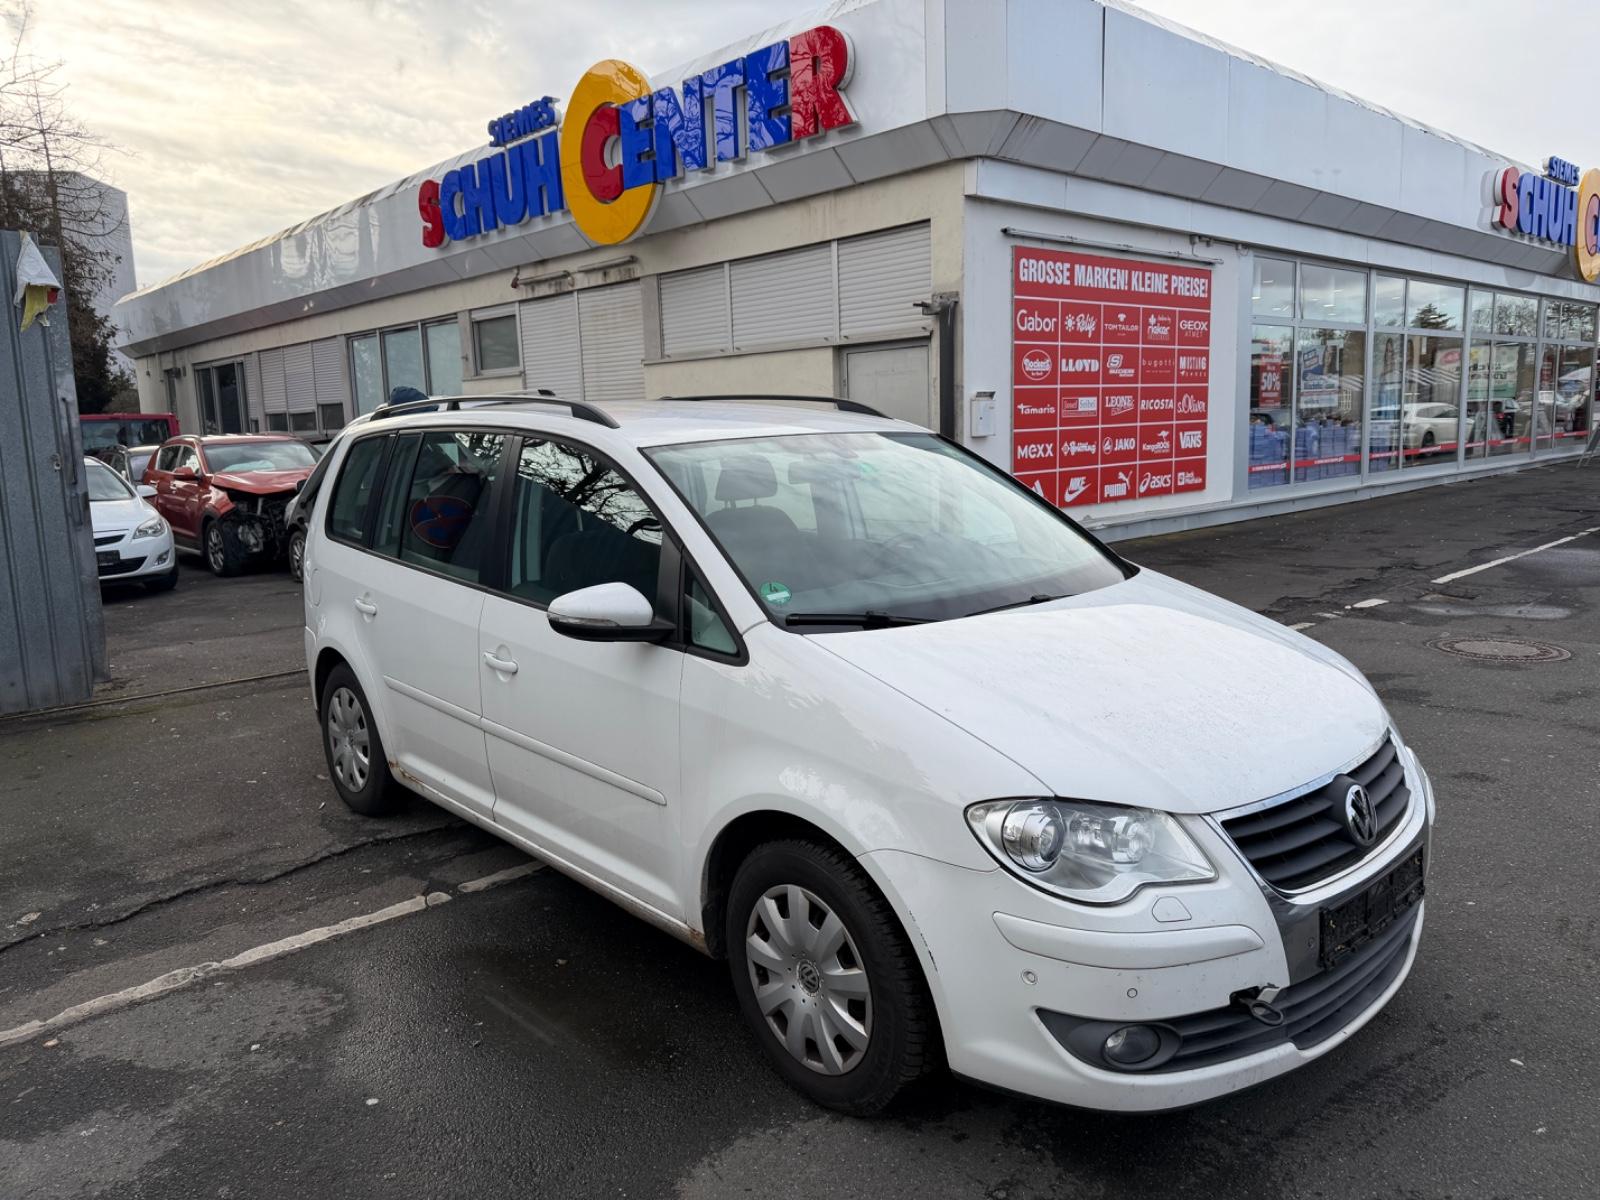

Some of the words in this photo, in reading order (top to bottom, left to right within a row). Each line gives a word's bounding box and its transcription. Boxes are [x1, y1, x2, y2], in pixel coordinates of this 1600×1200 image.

[488, 96, 557, 147] SIEMES
[418, 131, 565, 248] SCHUH
[581, 25, 857, 203] CENTER
[1500, 167, 1578, 246] SCHUH
[1019, 258, 1071, 285] GROSSE
[1074, 264, 1128, 290] MARKEN!
[1131, 271, 1168, 294] KLEINE
[1171, 275, 1208, 298] PREISE!
[1017, 309, 1057, 332] Gabor
[1180, 320, 1208, 331] GEOX
[1061, 358, 1099, 372] LLOYD
[1260, 372, 1281, 391] 50%
[1016, 403, 1056, 415] Tamaris
[1140, 399, 1173, 410] RICOSTA
[1114, 438, 1136, 451] JAKO
[1180, 430, 1202, 449] VANS
